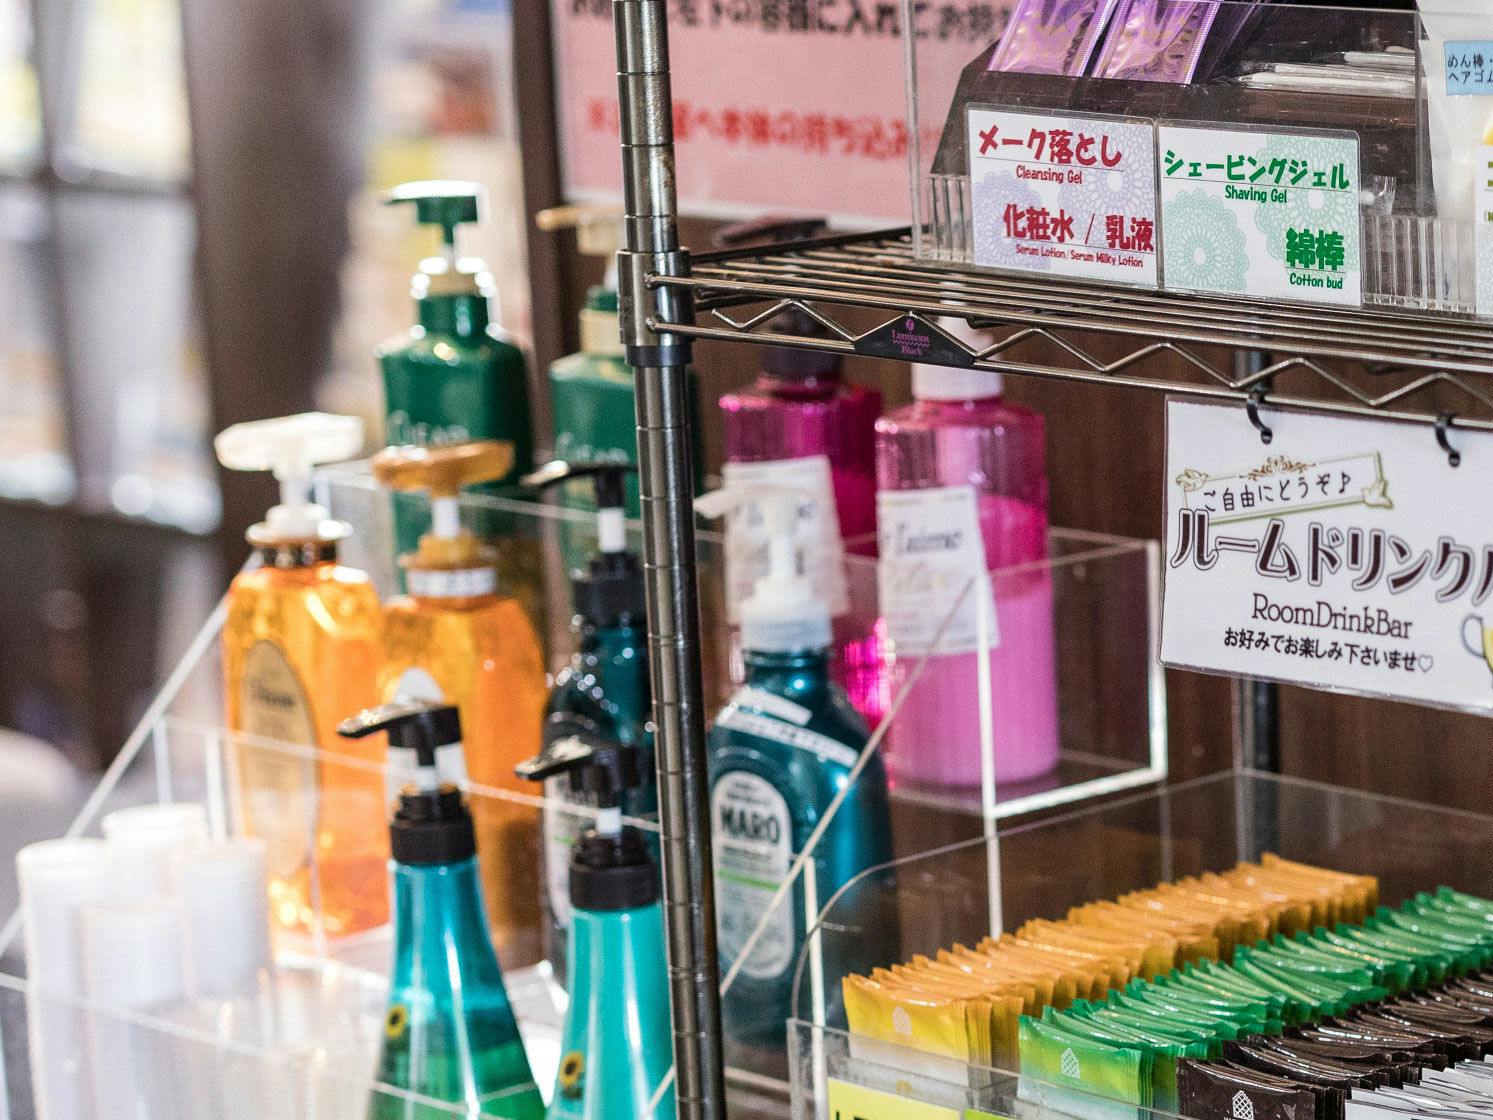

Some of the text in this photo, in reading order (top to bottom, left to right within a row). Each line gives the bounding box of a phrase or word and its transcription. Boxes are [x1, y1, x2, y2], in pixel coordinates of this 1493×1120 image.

[978, 125, 1122, 167] メーク落とし
[1016, 165, 1083, 185] Cleansing Gel
[1163, 149, 1350, 190] シェービングジェル
[1224, 184, 1288, 204] Shaving Gel
[1003, 203, 1075, 241] 化粧水
[1105, 214, 1154, 252] 乳液
[1285, 227, 1345, 271] 綿棒
[1289, 272, 1343, 290] Cotton bud
[1251, 592, 1414, 640] RoomDrinkBar
